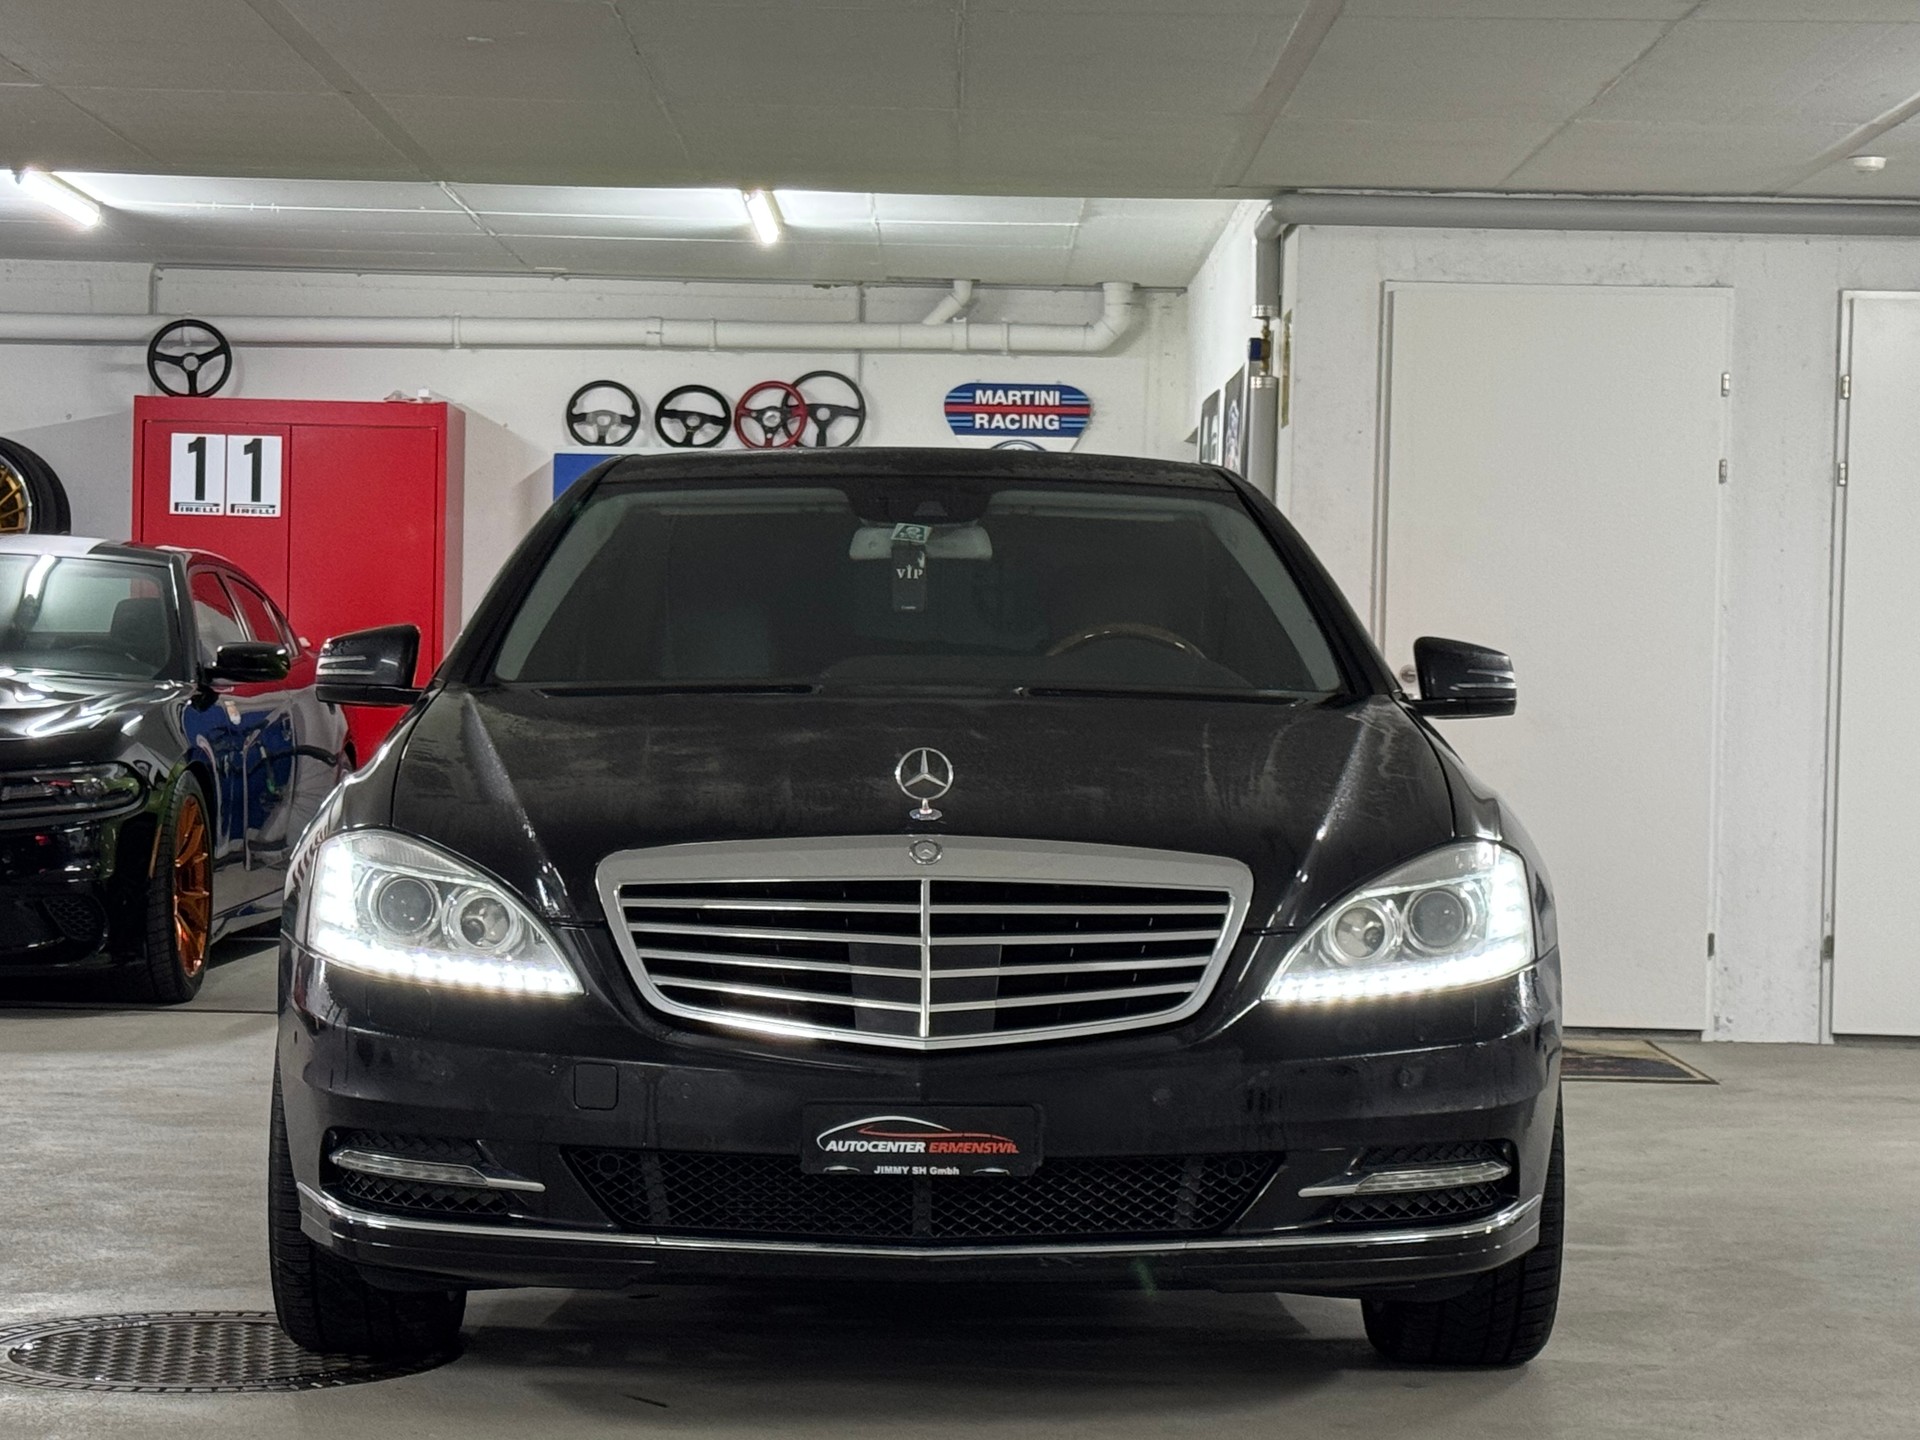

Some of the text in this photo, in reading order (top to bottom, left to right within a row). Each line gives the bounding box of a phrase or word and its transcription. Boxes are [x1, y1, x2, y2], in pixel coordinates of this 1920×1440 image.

[974, 389, 1060, 406] MARTINI
[974, 413, 1060, 430] RACING
[174, 502, 220, 513] PIRELLI
[230, 503, 276, 515] PIRELLI
[896, 564, 923, 579] VIP
[825, 1140, 926, 1153] AUTOCENTER
[873, 1165, 960, 1175] JIMMY SH Gmbh
